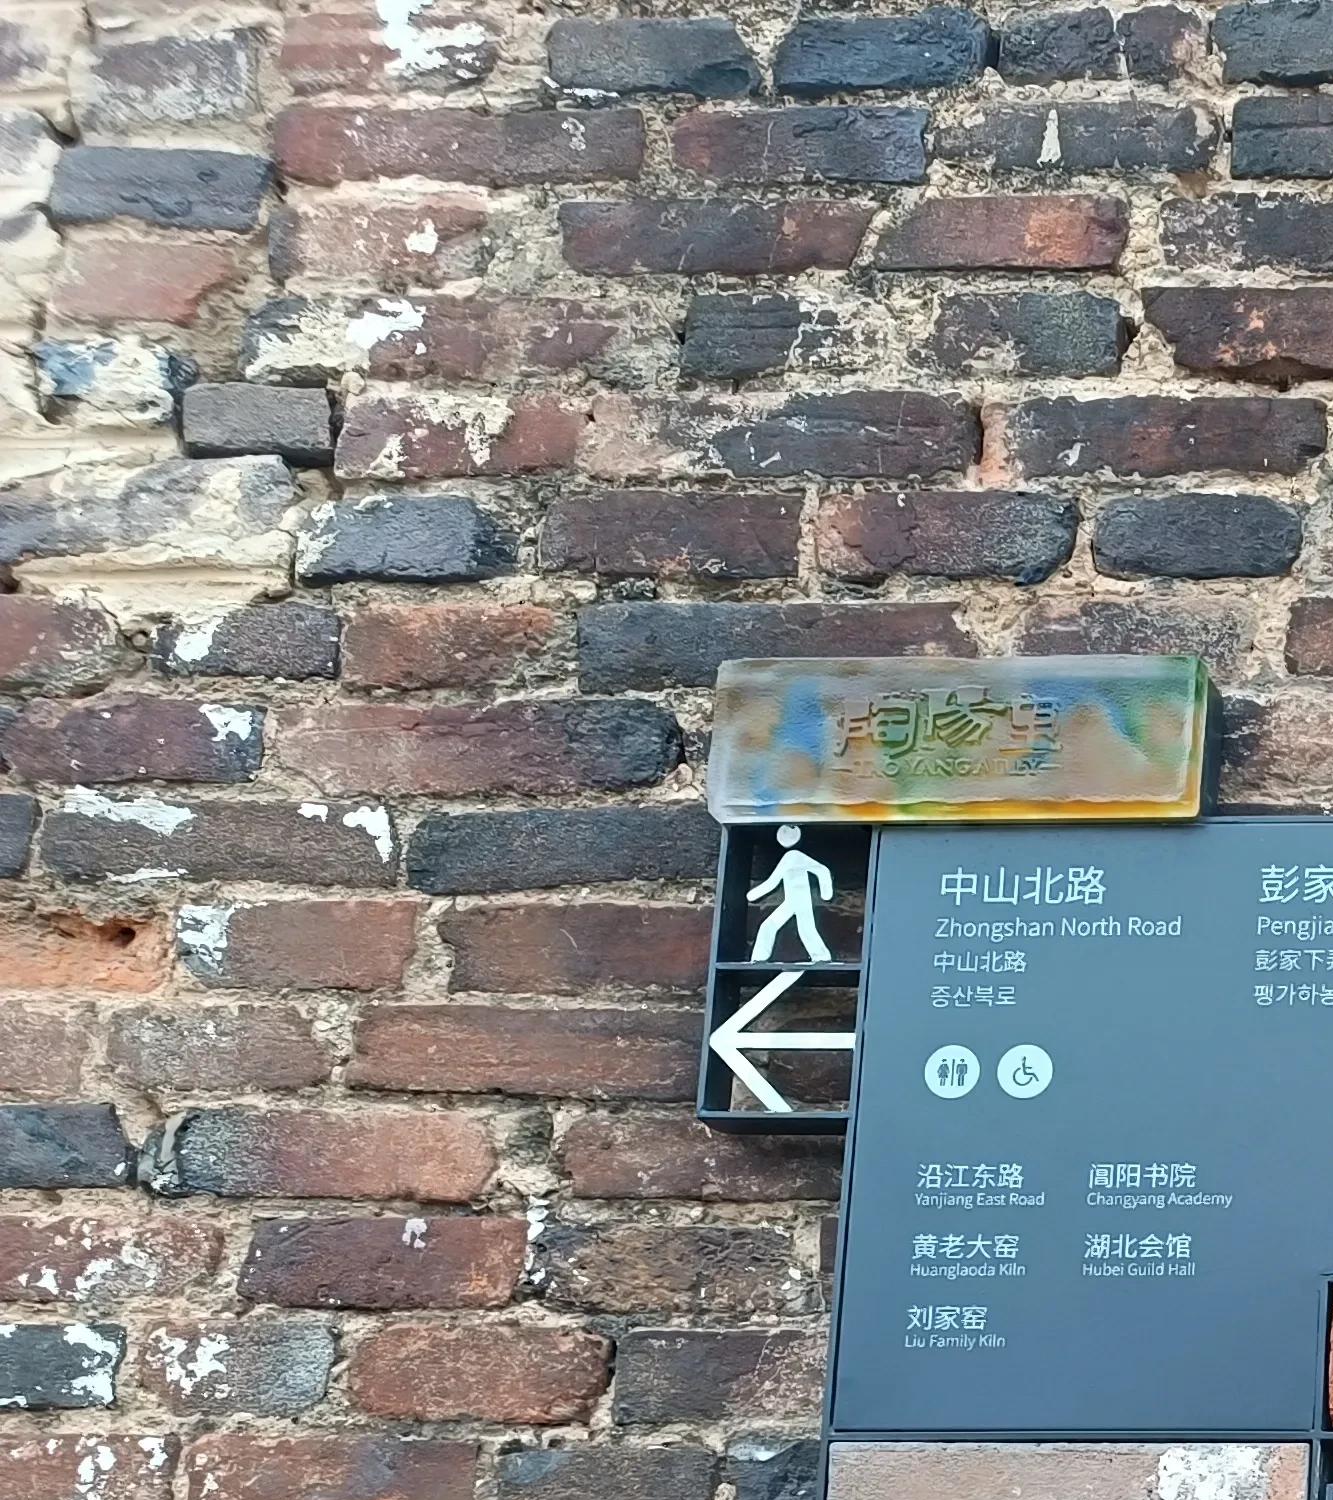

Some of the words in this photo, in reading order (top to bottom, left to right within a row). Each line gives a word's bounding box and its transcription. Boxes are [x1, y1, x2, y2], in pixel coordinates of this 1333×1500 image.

[941, 866, 1106, 905] 中山北路
[935, 917, 1053, 942] Zhongshan
[1062, 916, 1120, 936] North
[1129, 916, 1181, 935] Road
[934, 951, 1026, 973] 中山北路
[918, 1163, 1024, 1188] 沿江东路
[915, 1192, 973, 1209] Yanjiang
[977, 1193, 1006, 1205] East
[1010, 1192, 1044, 1205] Road
[1087, 1192, 1165, 1209] Changyang
[1168, 1192, 1232, 1208] Academy
[912, 1234, 1019, 1259] 黄老大窑
[1085, 1233, 1191, 1258] 湖北会馆
[911, 1263, 995, 1279] Huanglaoda
[1000, 1263, 1025, 1275] Kiln
[1083, 1263, 1123, 1276] Hubei
[1128, 1262, 1164, 1275] Guild
[1169, 1262, 1195, 1275] Hall
[907, 1305, 987, 1330] 刘家窑
[905, 1335, 925, 1347] Liu
[930, 1334, 975, 1350] Family
[979, 1334, 1005, 1347] Kiln
